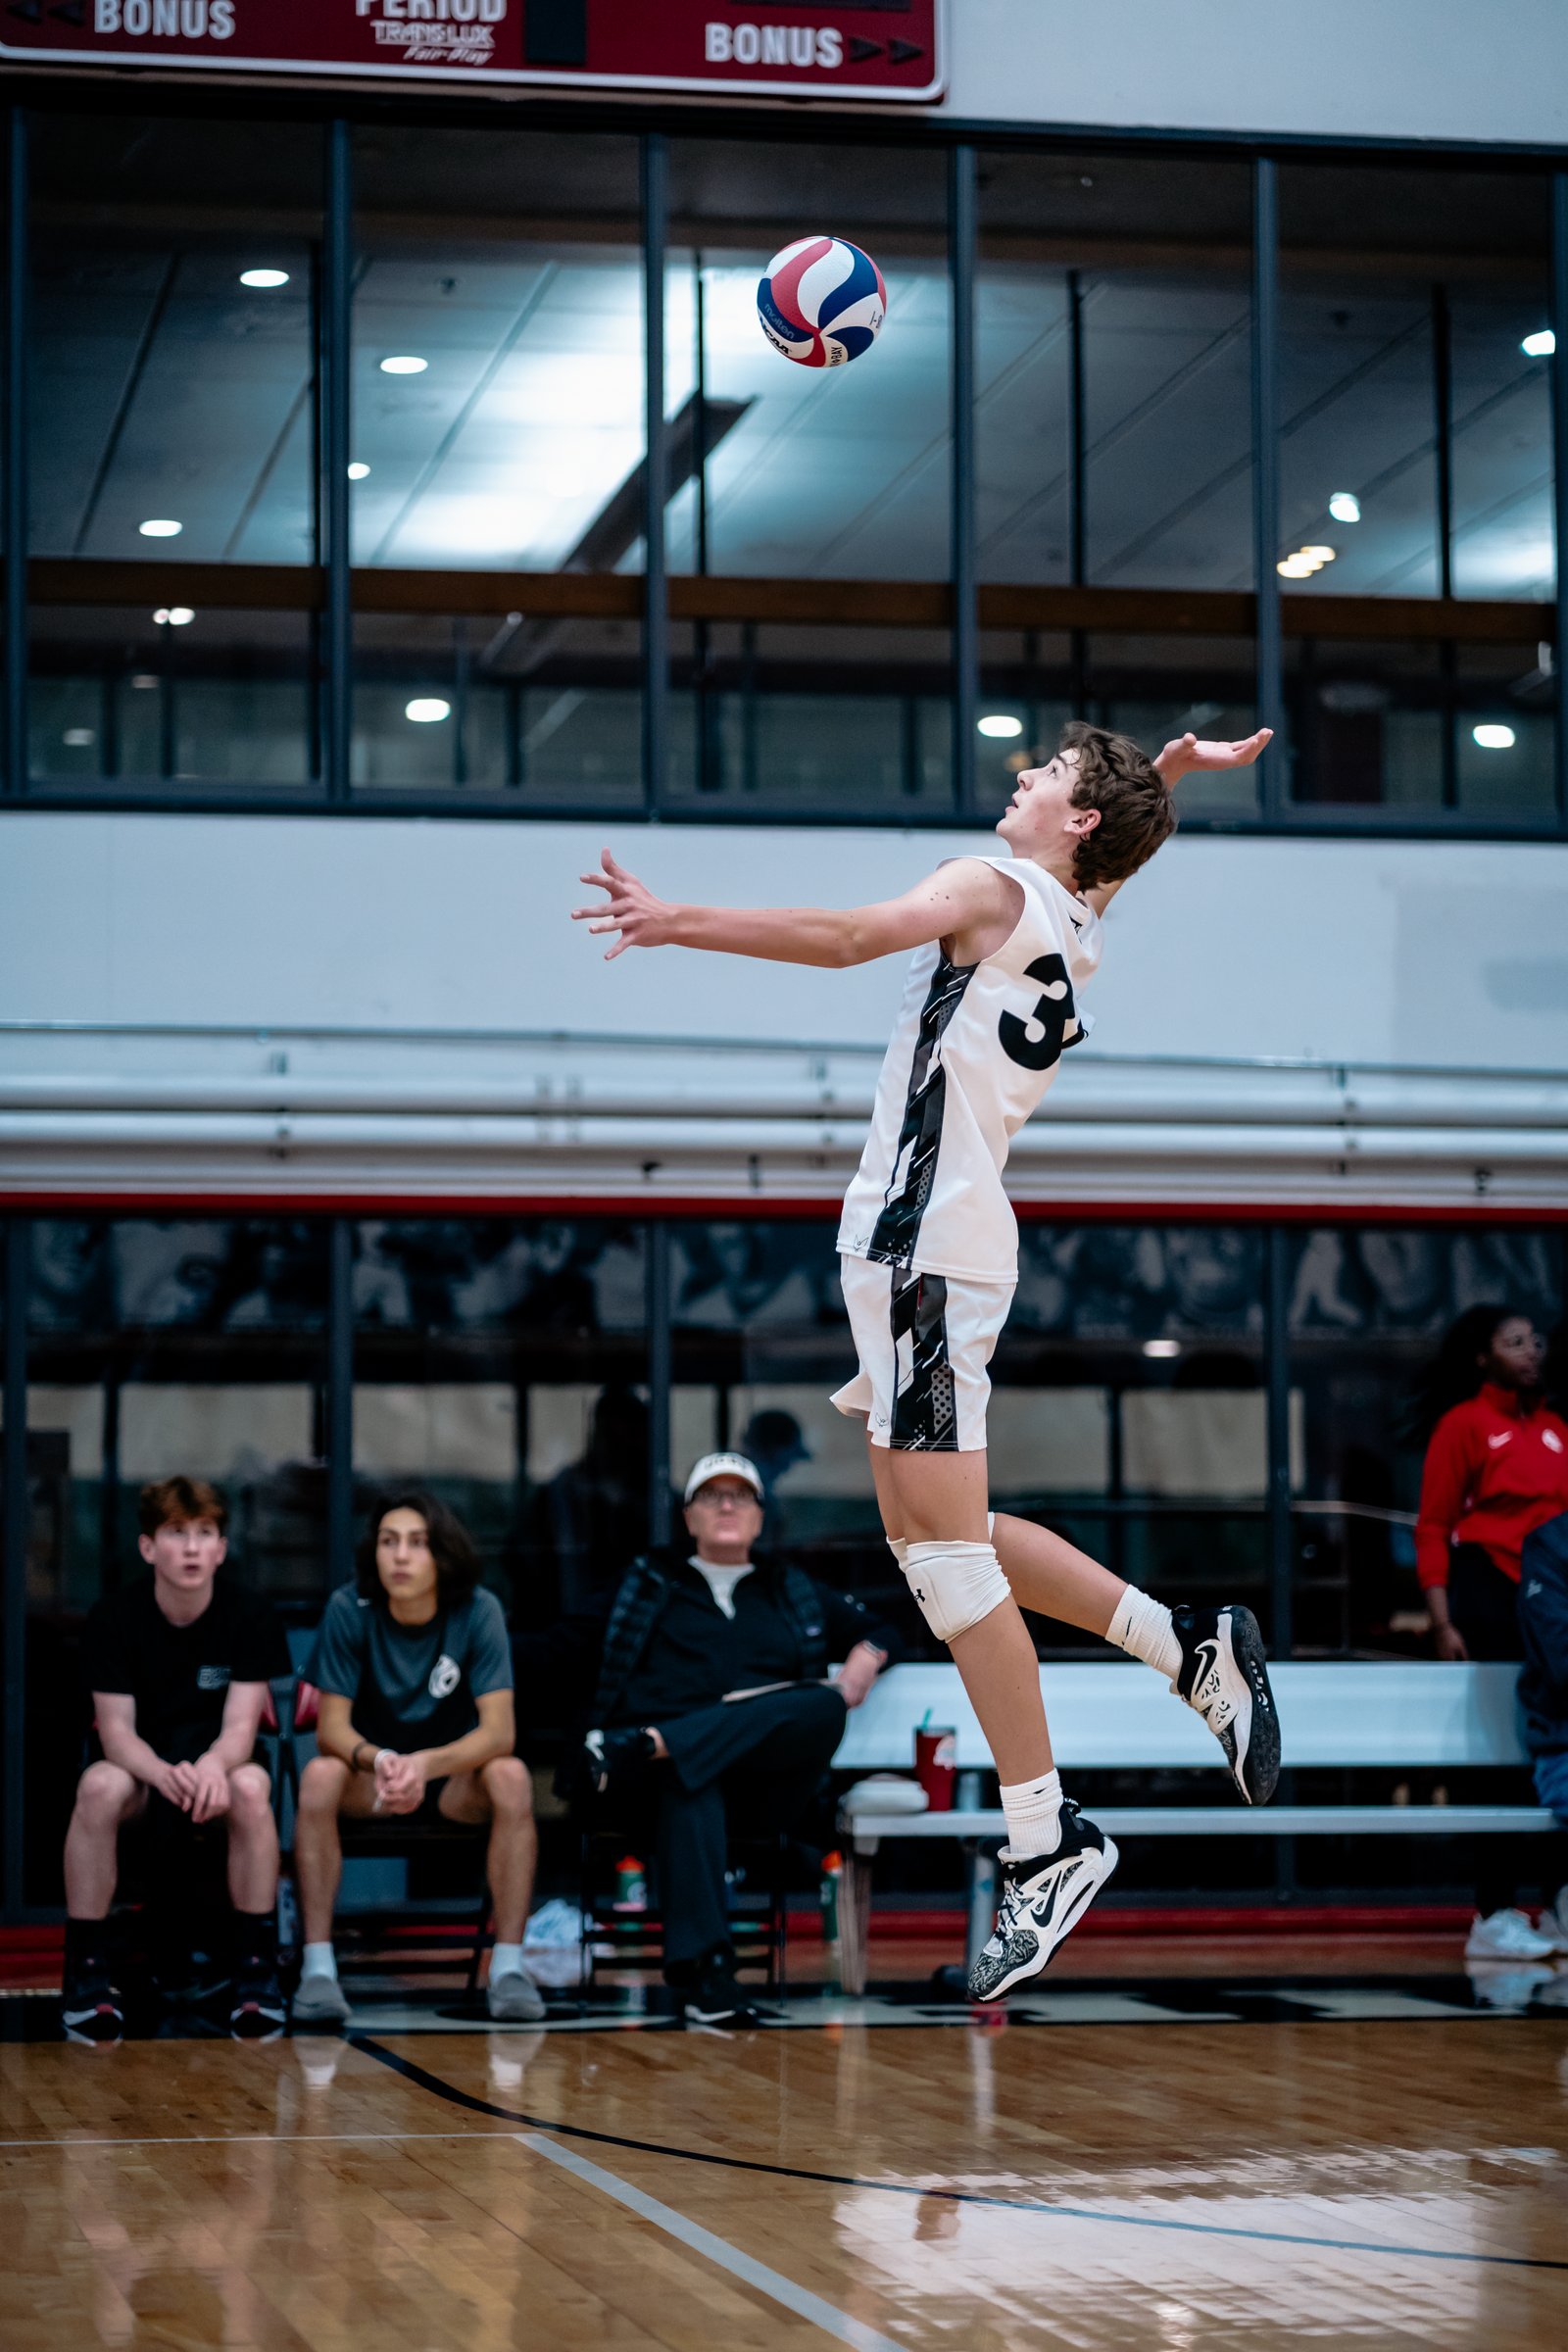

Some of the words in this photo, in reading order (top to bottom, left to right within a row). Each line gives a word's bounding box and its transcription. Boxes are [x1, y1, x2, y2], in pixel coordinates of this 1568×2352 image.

[94, 0, 235, 40] BONUS
[705, 22, 844, 69] BONUS
[764, 303, 795, 340] molten
